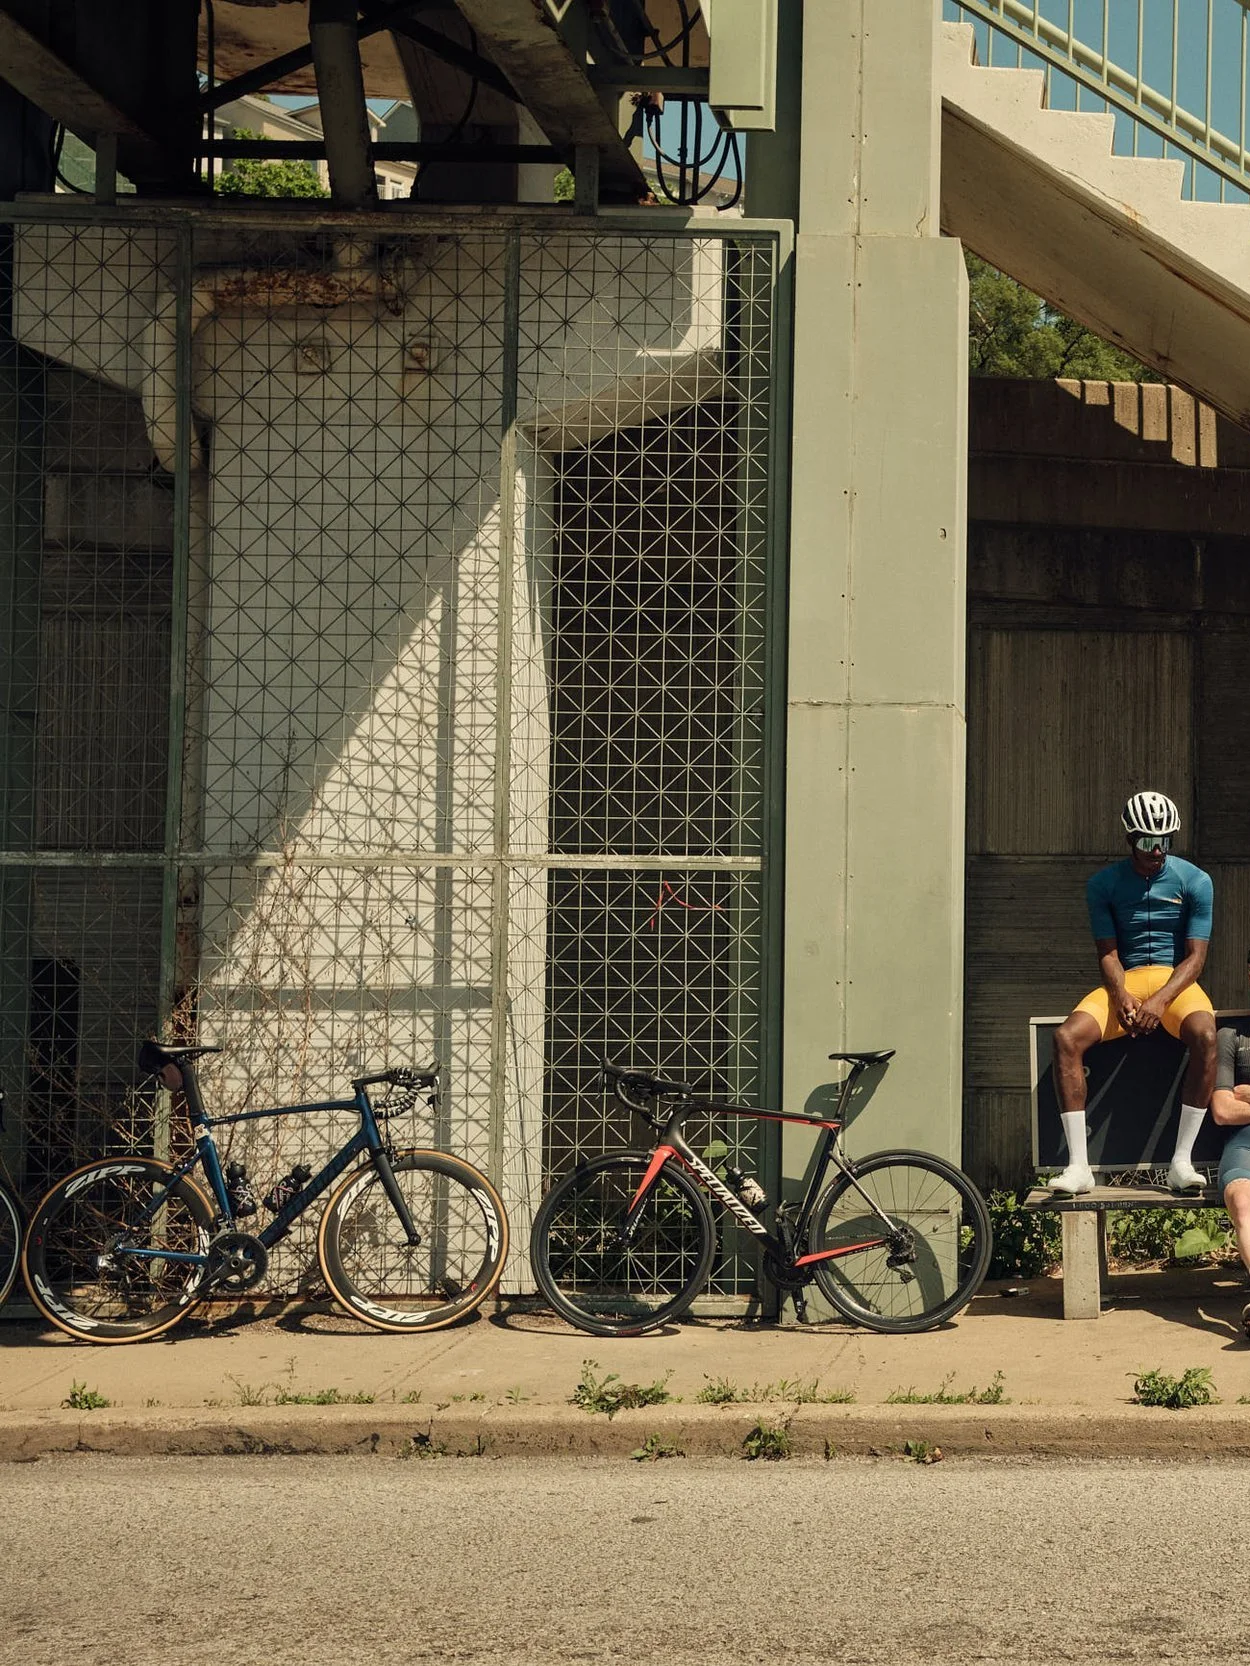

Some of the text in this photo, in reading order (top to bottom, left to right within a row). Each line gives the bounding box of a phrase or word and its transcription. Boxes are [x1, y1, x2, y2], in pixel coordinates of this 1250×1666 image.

[65, 1165, 147, 1198] ZIPP
[685, 1155, 768, 1235] SPECIALIZED
[471, 1187, 499, 1263] ZIPP
[34, 1273, 99, 1331] ZIPP
[350, 1295, 431, 1323] ZIPP
